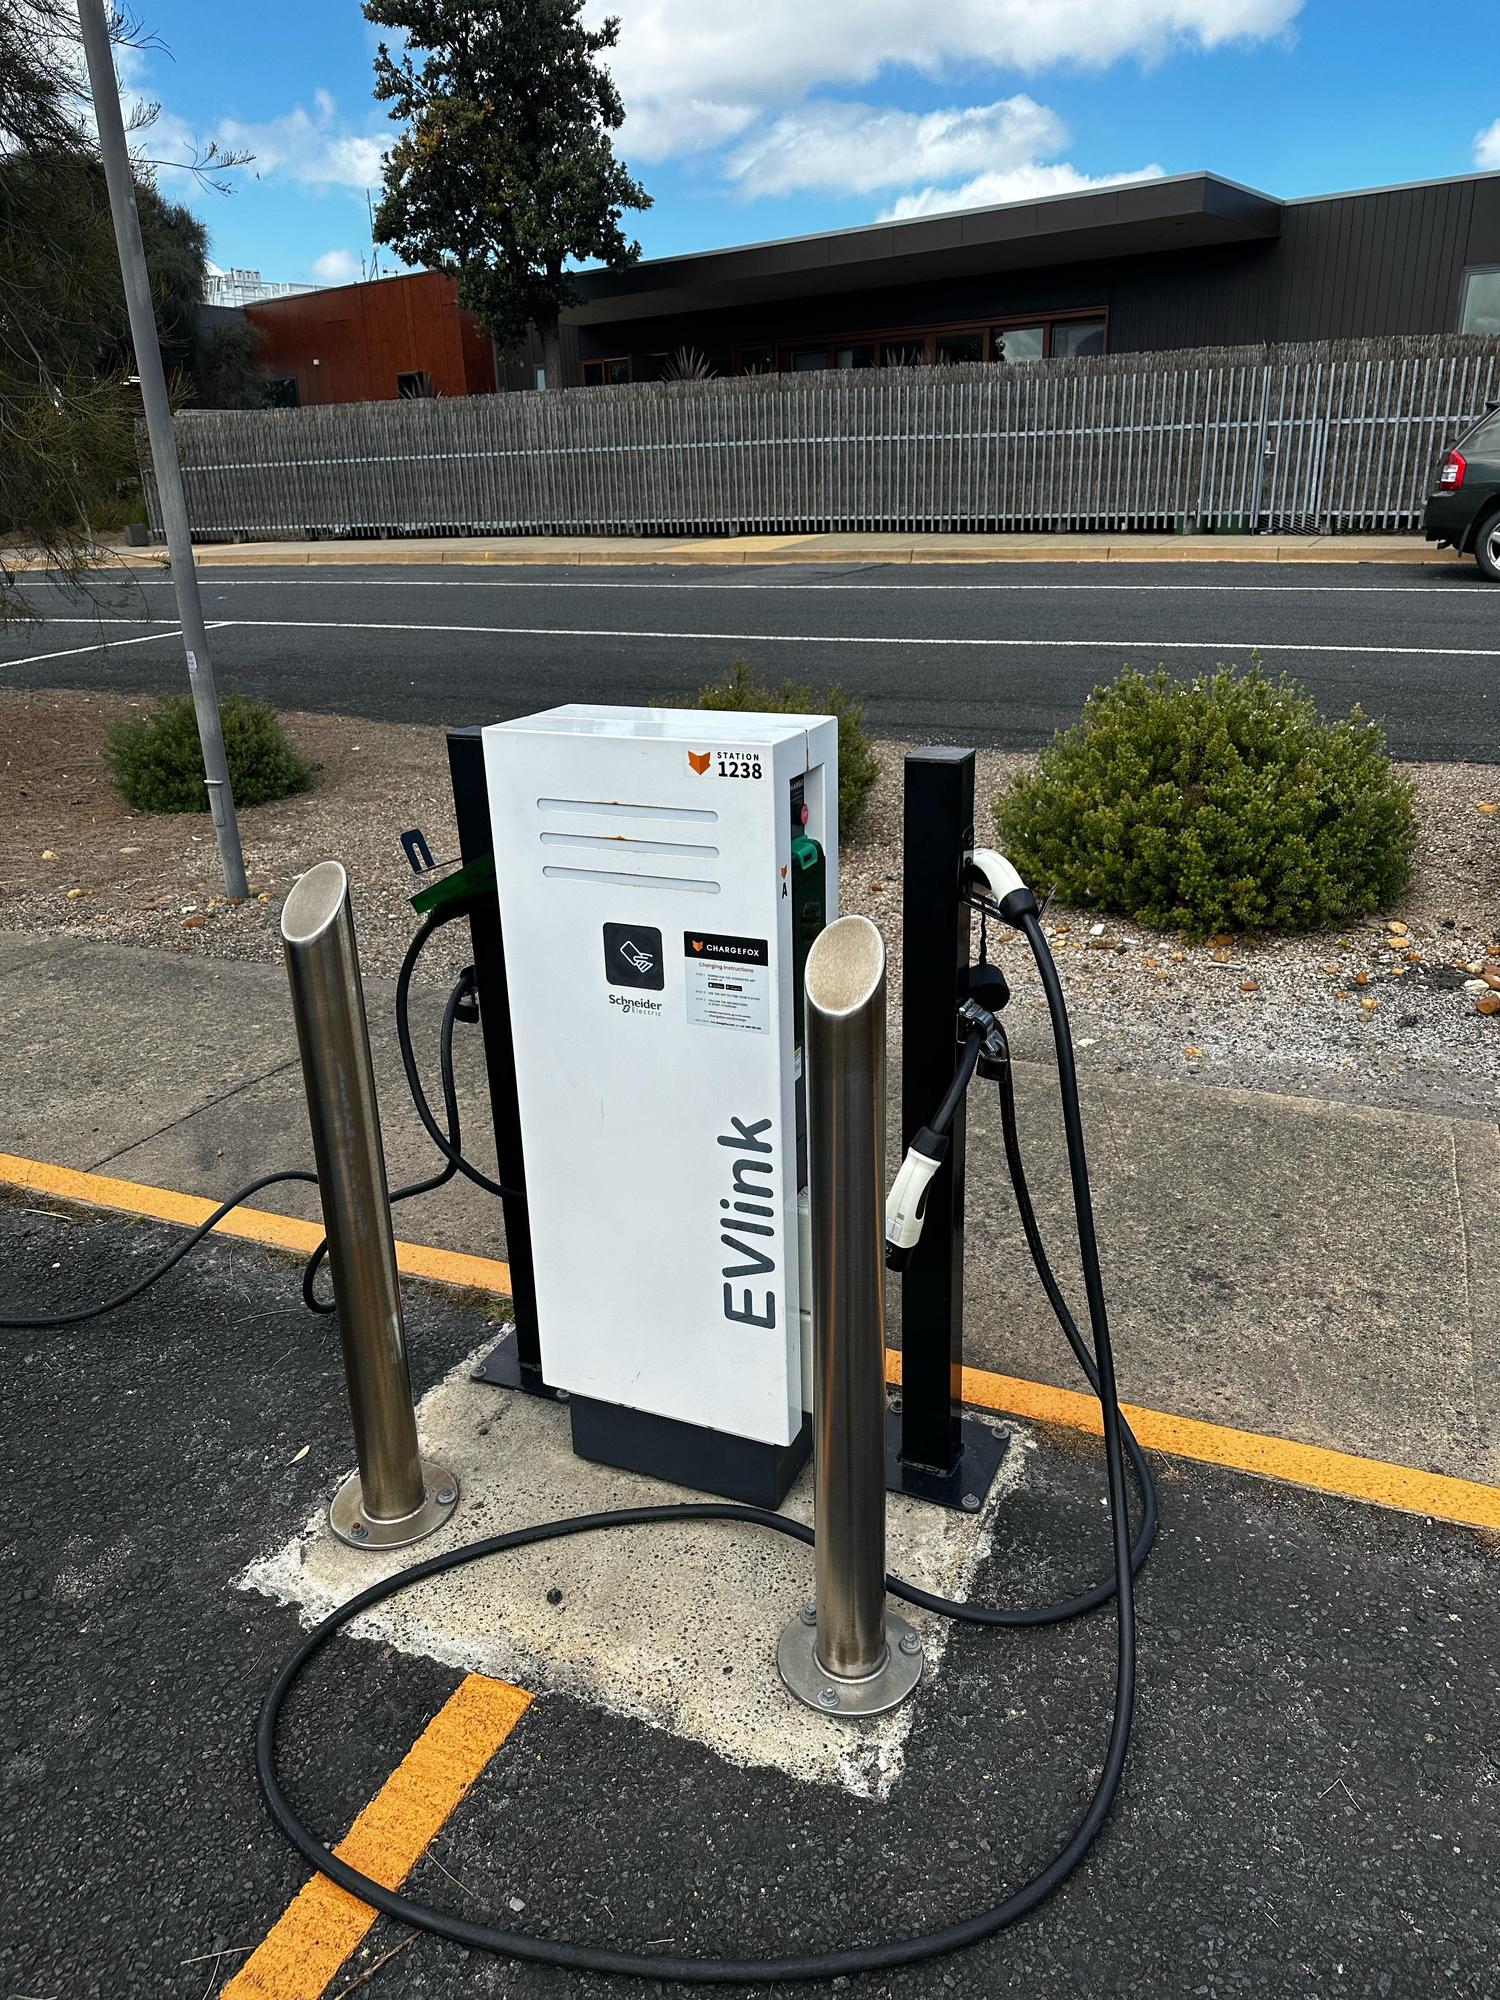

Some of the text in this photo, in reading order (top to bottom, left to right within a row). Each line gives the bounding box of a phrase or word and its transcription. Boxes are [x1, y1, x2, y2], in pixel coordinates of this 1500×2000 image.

[717, 751, 760, 761] STATION
[718, 761, 763, 779] 1238
[781, 882, 788, 899] A
[706, 943, 760, 958] CHARGEFOX
[698, 961, 723, 971] Charging
[608, 994, 662, 1011] Schneider
[632, 1004, 662, 1016] Electric
[716, 1116, 776, 1330] EVlink
